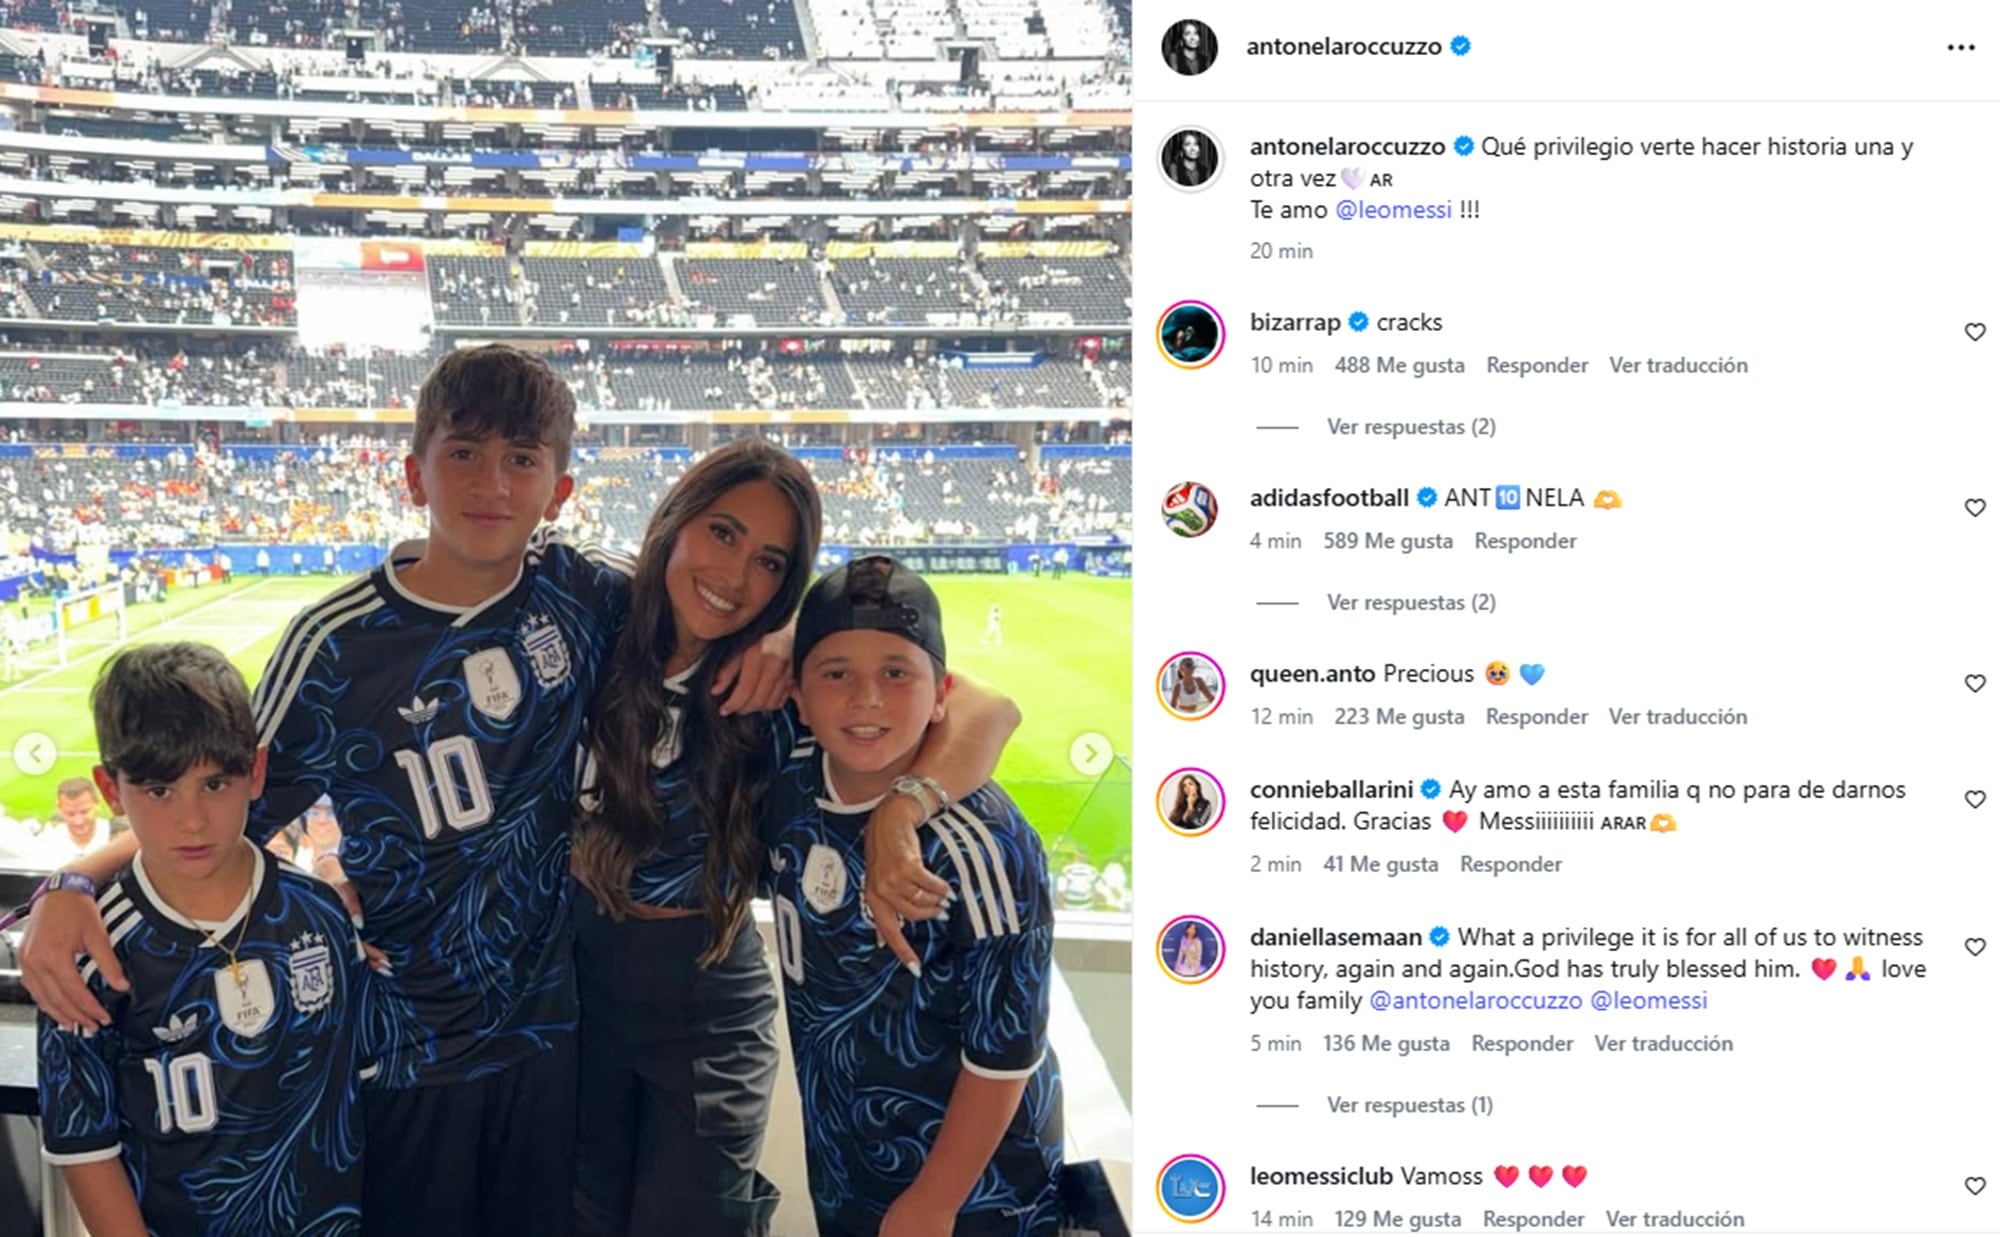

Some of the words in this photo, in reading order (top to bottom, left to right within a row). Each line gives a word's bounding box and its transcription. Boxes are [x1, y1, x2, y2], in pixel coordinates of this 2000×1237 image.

[486, 692, 510, 704] FIFA
[393, 735, 495, 840] 10
[301, 966, 324, 992] AFA
[236, 1007, 262, 1020] FIFA
[143, 1052, 219, 1134] 10
